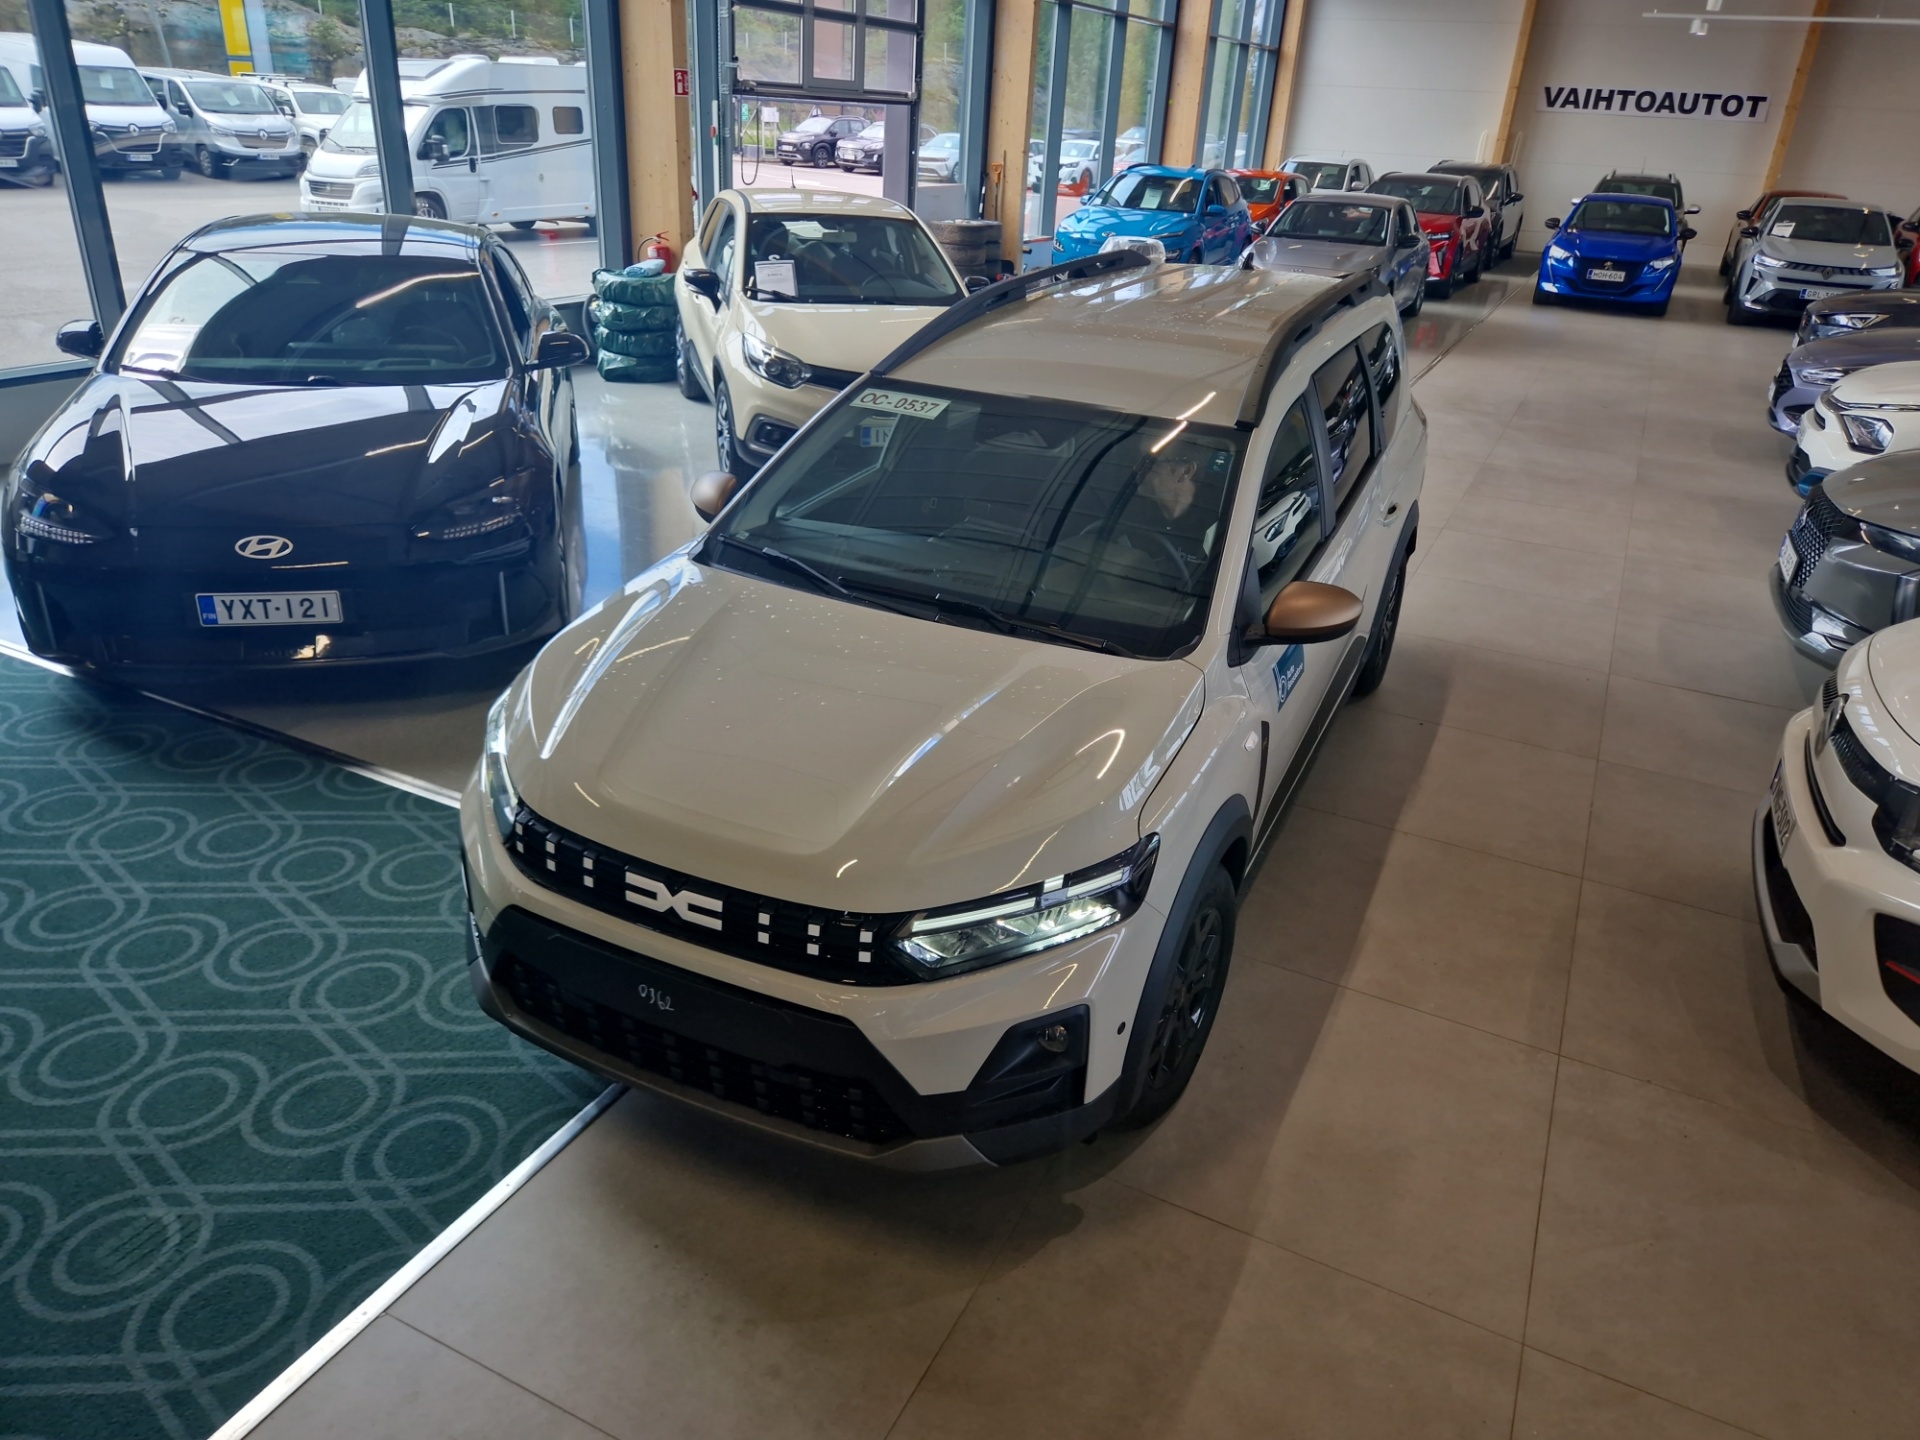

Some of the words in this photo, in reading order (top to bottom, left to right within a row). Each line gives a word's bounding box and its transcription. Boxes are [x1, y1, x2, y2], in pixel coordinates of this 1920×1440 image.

[1544, 86, 1768, 118] VAIHTOAUTOT
[860, 392, 940, 414] OC-0537
[221, 597, 329, 620] YXT-121
[638, 984, 675, 1010] 0362
